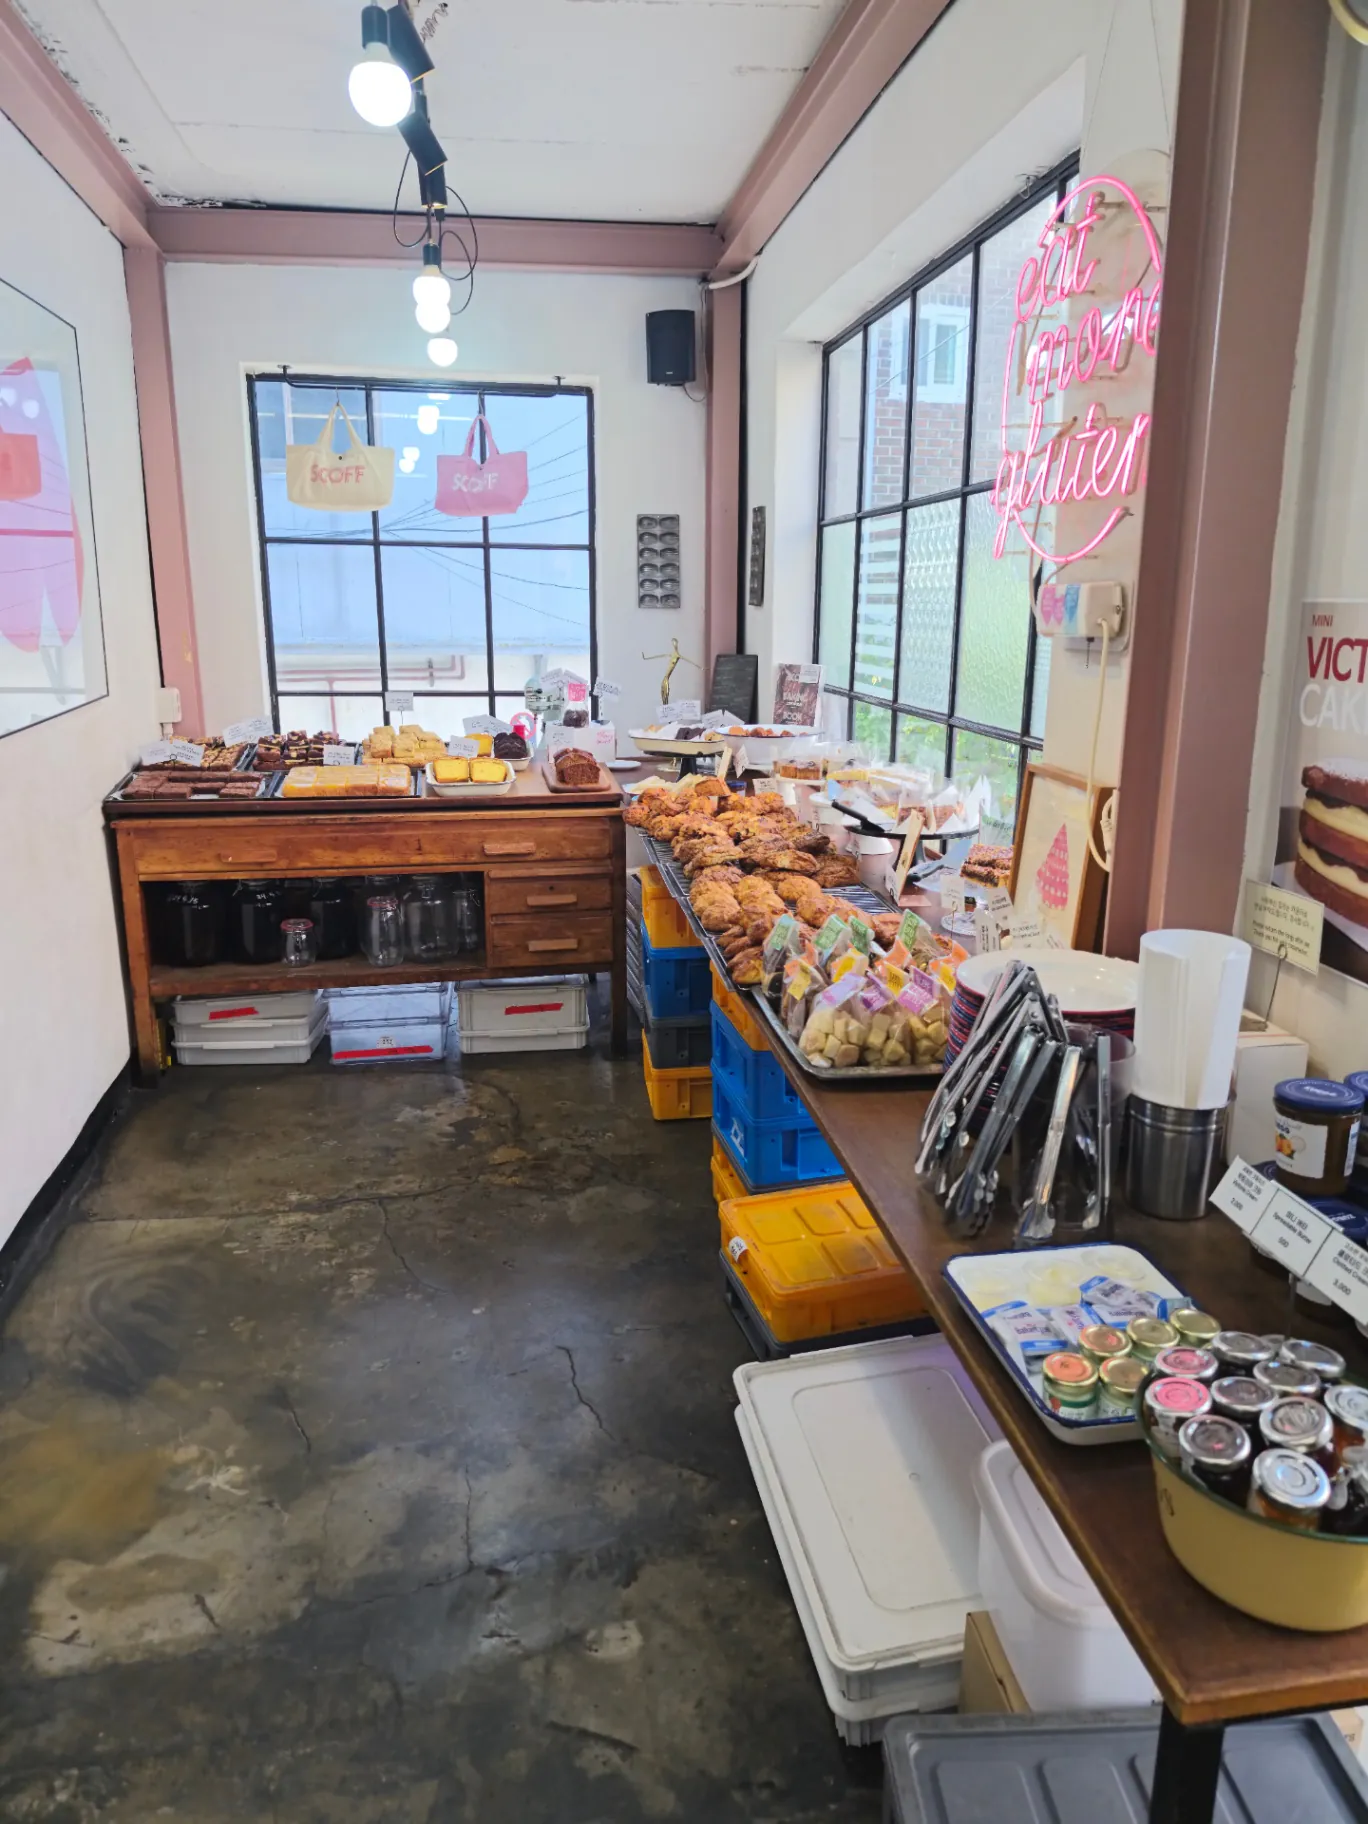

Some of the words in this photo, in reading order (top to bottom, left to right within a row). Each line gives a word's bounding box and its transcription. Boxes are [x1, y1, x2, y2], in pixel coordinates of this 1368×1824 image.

[1015, 191, 1102, 321] eat
[1027, 280, 1160, 404] more
[310, 464, 365, 484] SCOFF
[1312, 614, 1333, 627] MINI
[1307, 636, 1368, 683] VICT
[1299, 683, 1368, 735] CAK
